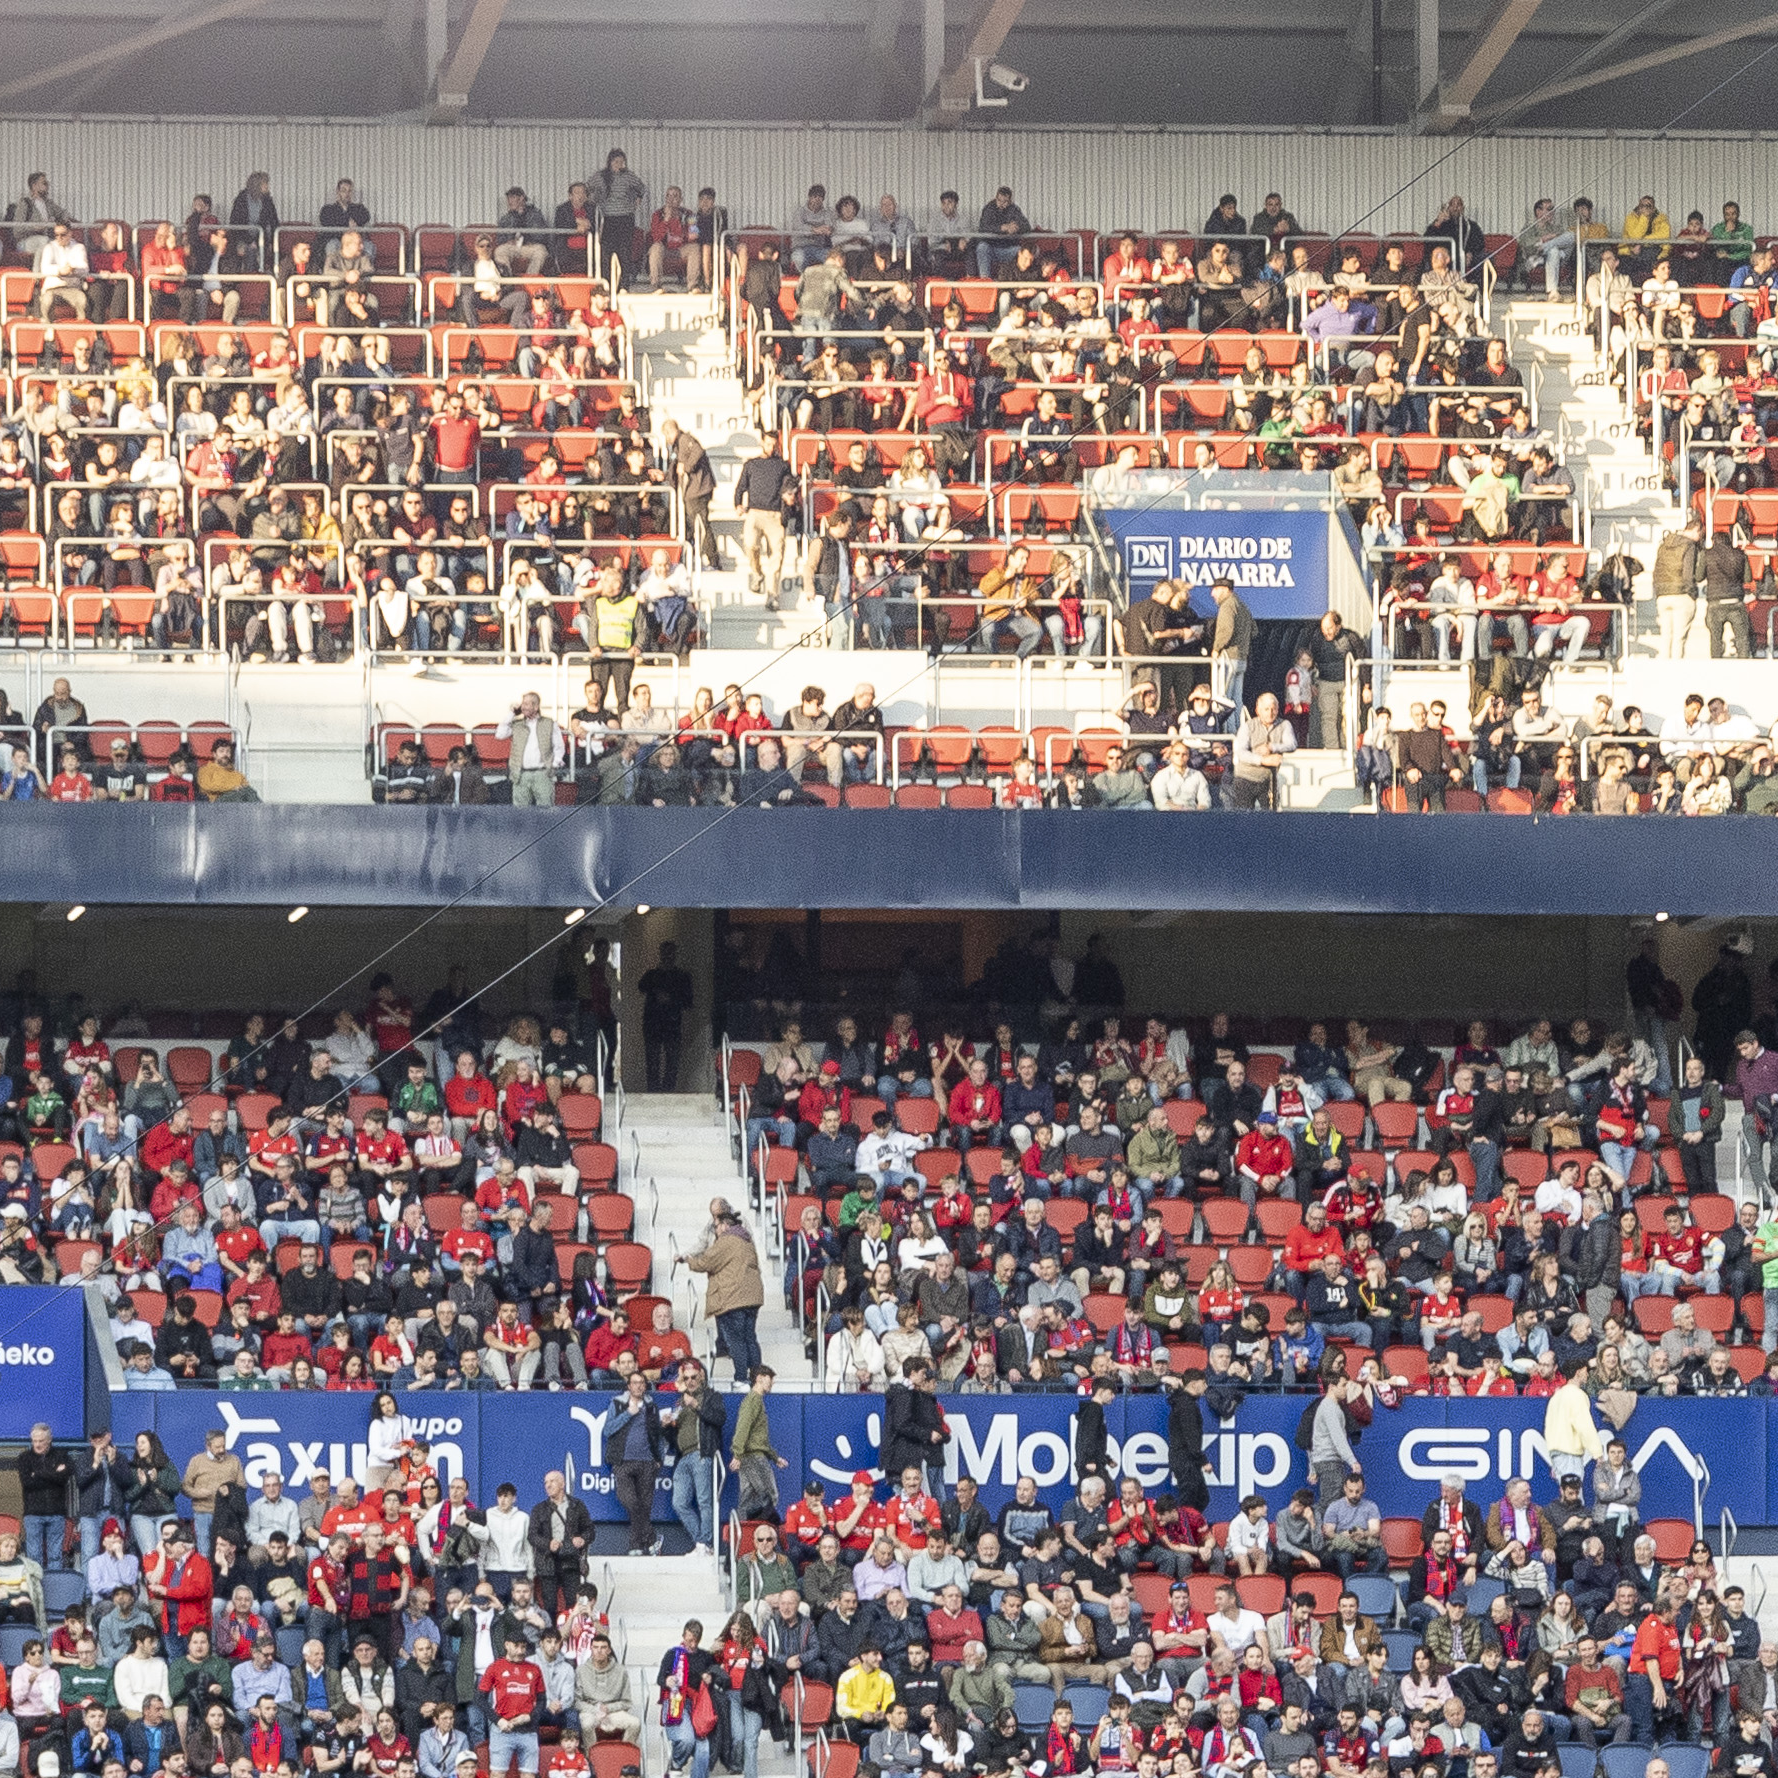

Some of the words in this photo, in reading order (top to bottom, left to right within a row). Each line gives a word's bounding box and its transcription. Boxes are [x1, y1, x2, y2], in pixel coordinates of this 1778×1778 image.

[1132, 544, 1165, 566] DN
[1180, 537, 1258, 560] DIARIO
[1260, 538, 1292, 560] DE
[1179, 562, 1295, 588] NAVARRA
